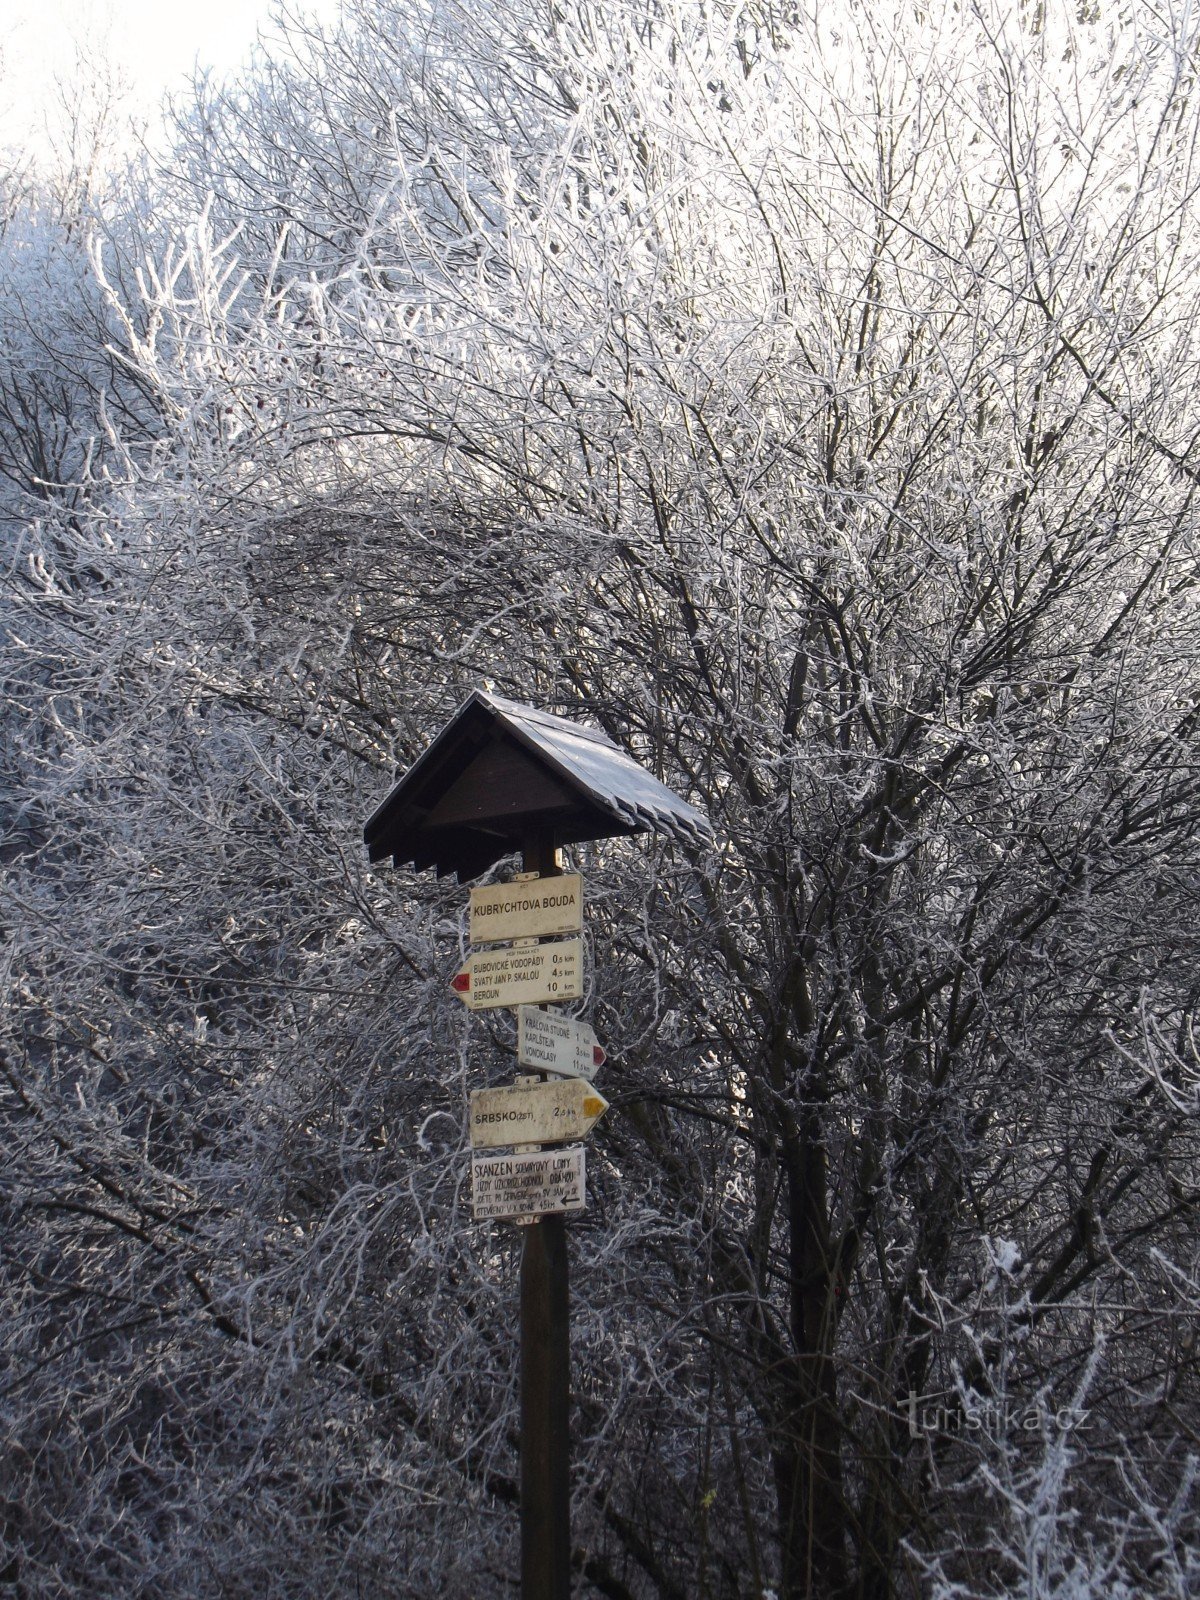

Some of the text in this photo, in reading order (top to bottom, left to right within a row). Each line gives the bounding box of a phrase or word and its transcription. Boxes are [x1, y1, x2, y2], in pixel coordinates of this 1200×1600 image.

[474, 894, 576, 917] KUBRYCHTOVA BOUDA
[473, 958, 510, 974] BUBOVICKÉ
[510, 955, 545, 969] VODOPÁDY
[474, 976, 493, 987] SVATÝ
[493, 974, 508, 985] JAN
[514, 970, 540, 982] SKALOU
[473, 989, 500, 1001] BEROUN
[547, 982, 558, 992] 10
[525, 1032, 555, 1048] KARLŠTEJN
[525, 1045, 557, 1062] VONOKLASY
[474, 1162, 513, 1178] SKANZEN
[552, 1158, 571, 1170] LOMY
